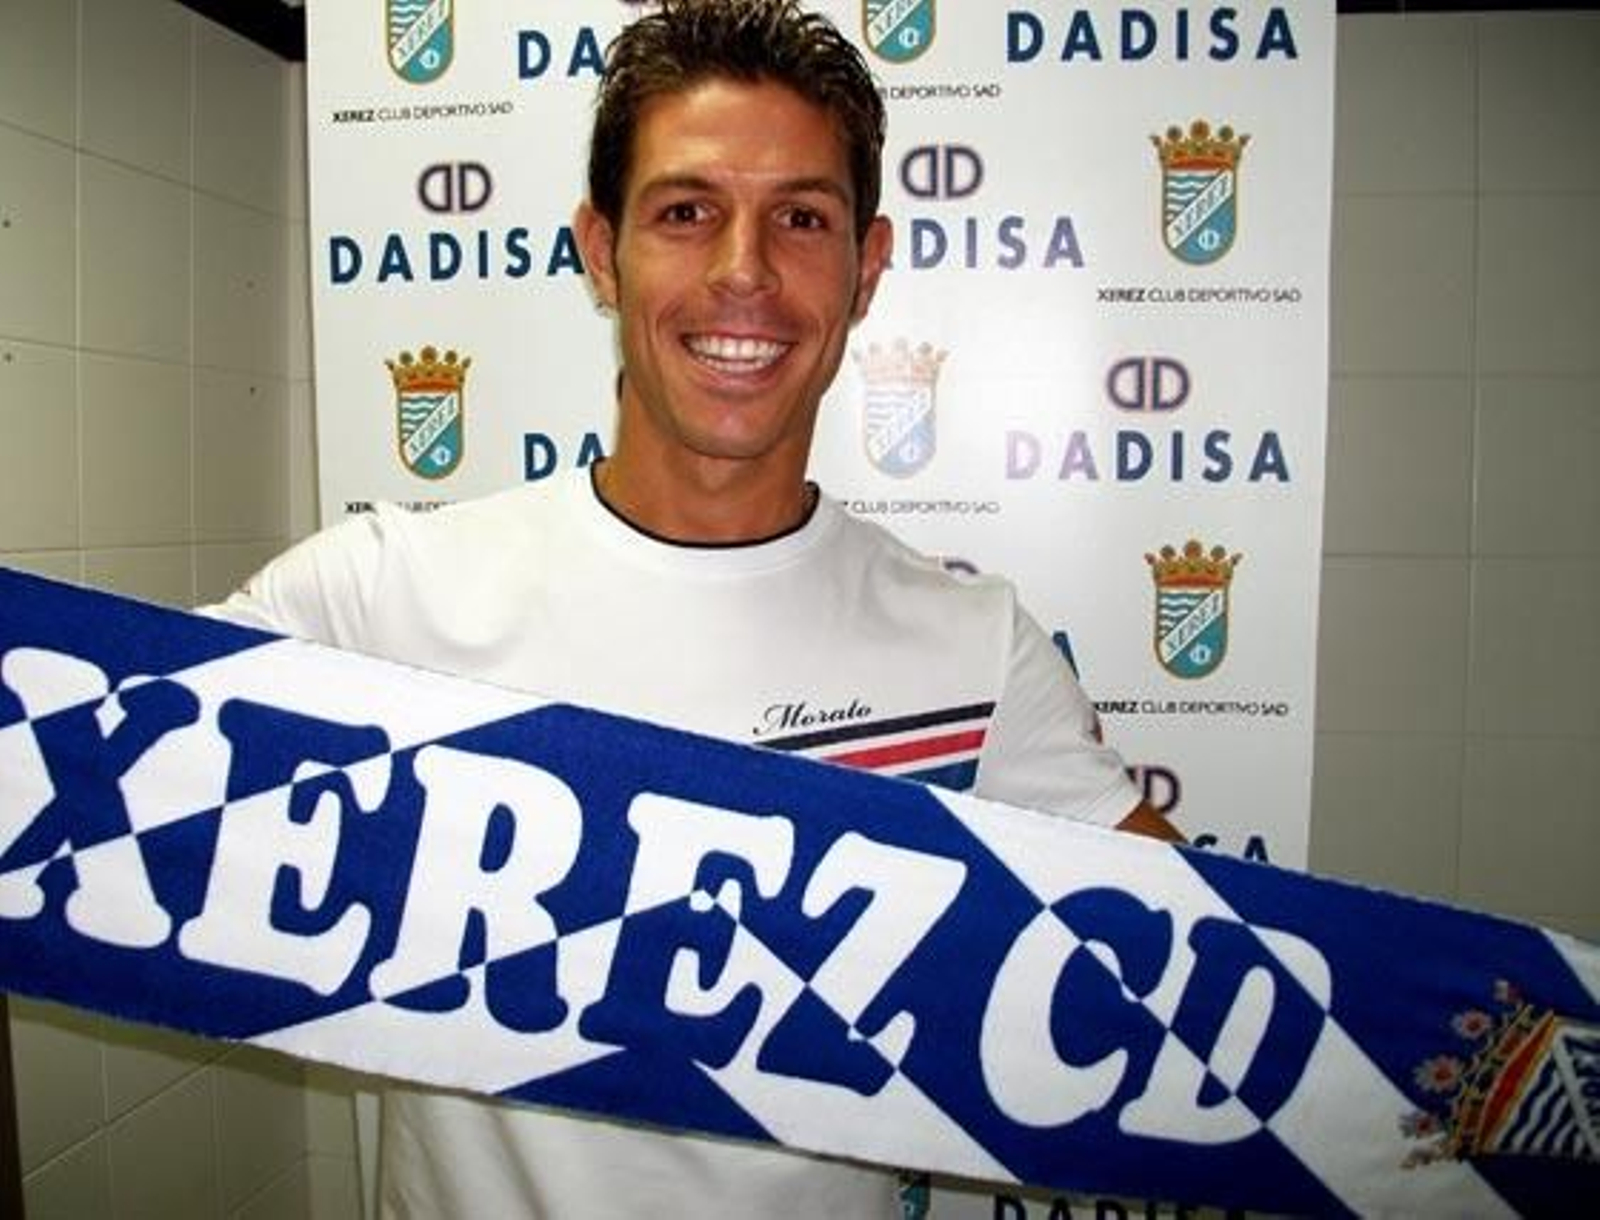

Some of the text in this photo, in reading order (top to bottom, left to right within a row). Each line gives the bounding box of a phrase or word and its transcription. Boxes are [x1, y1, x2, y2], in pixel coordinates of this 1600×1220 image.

[1006, 8, 1298, 63] DADISA
[972, 83, 1001, 98] SAD
[332, 109, 375, 123] XEREZ
[377, 106, 411, 121] CLUB
[488, 100, 515, 115] SAD
[329, 226, 585, 285] DADISA
[883, 215, 1085, 270] DISA
[1097, 288, 1301, 303] XEREZ CLUB DEPORTIVO SAD
[1005, 429, 1291, 483] DADISA
[1141, 701, 1177, 714] CLUB
